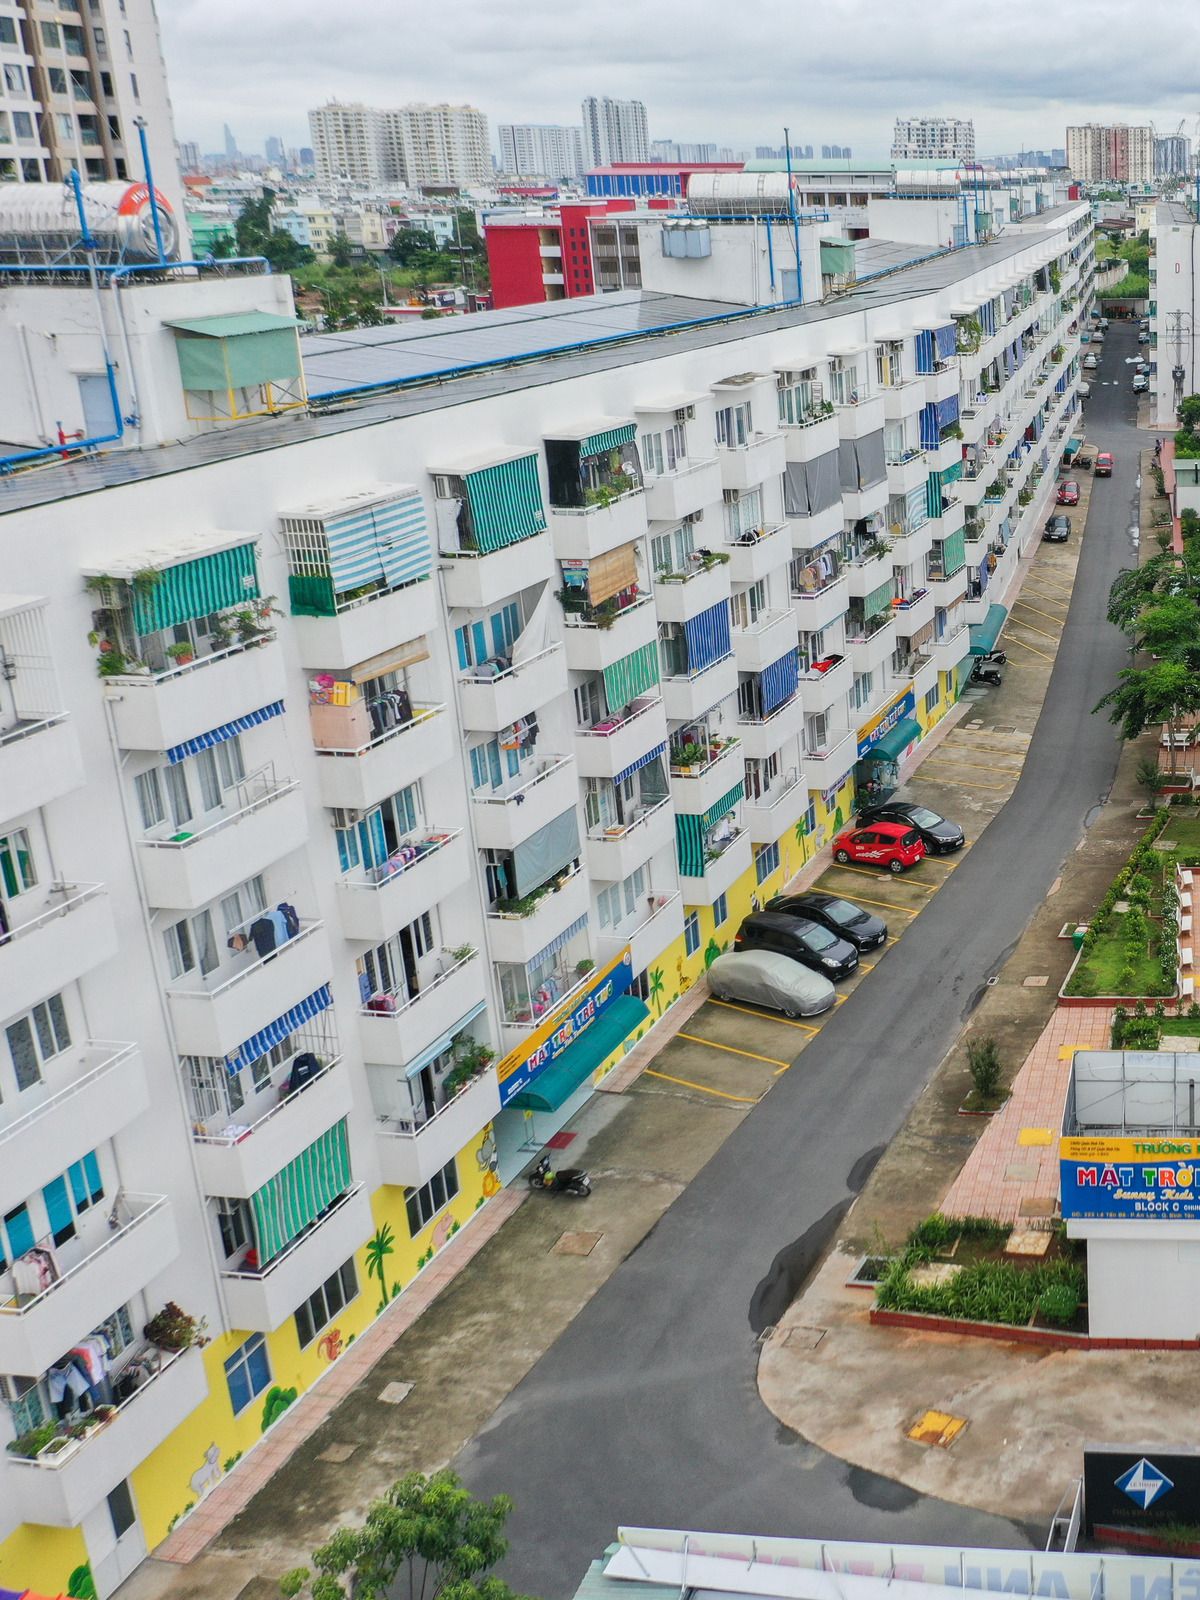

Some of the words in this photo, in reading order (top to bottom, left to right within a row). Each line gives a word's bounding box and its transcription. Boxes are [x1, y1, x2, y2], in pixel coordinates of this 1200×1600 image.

[1133, 1139, 1192, 1154] TRƯỜNG
[1076, 1162, 1135, 1190] MẶT
[1113, 1188, 1156, 1202] Sunny
[1159, 1188, 1195, 1200] Kids
[1134, 1201, 1169, 1212] BLOCK
